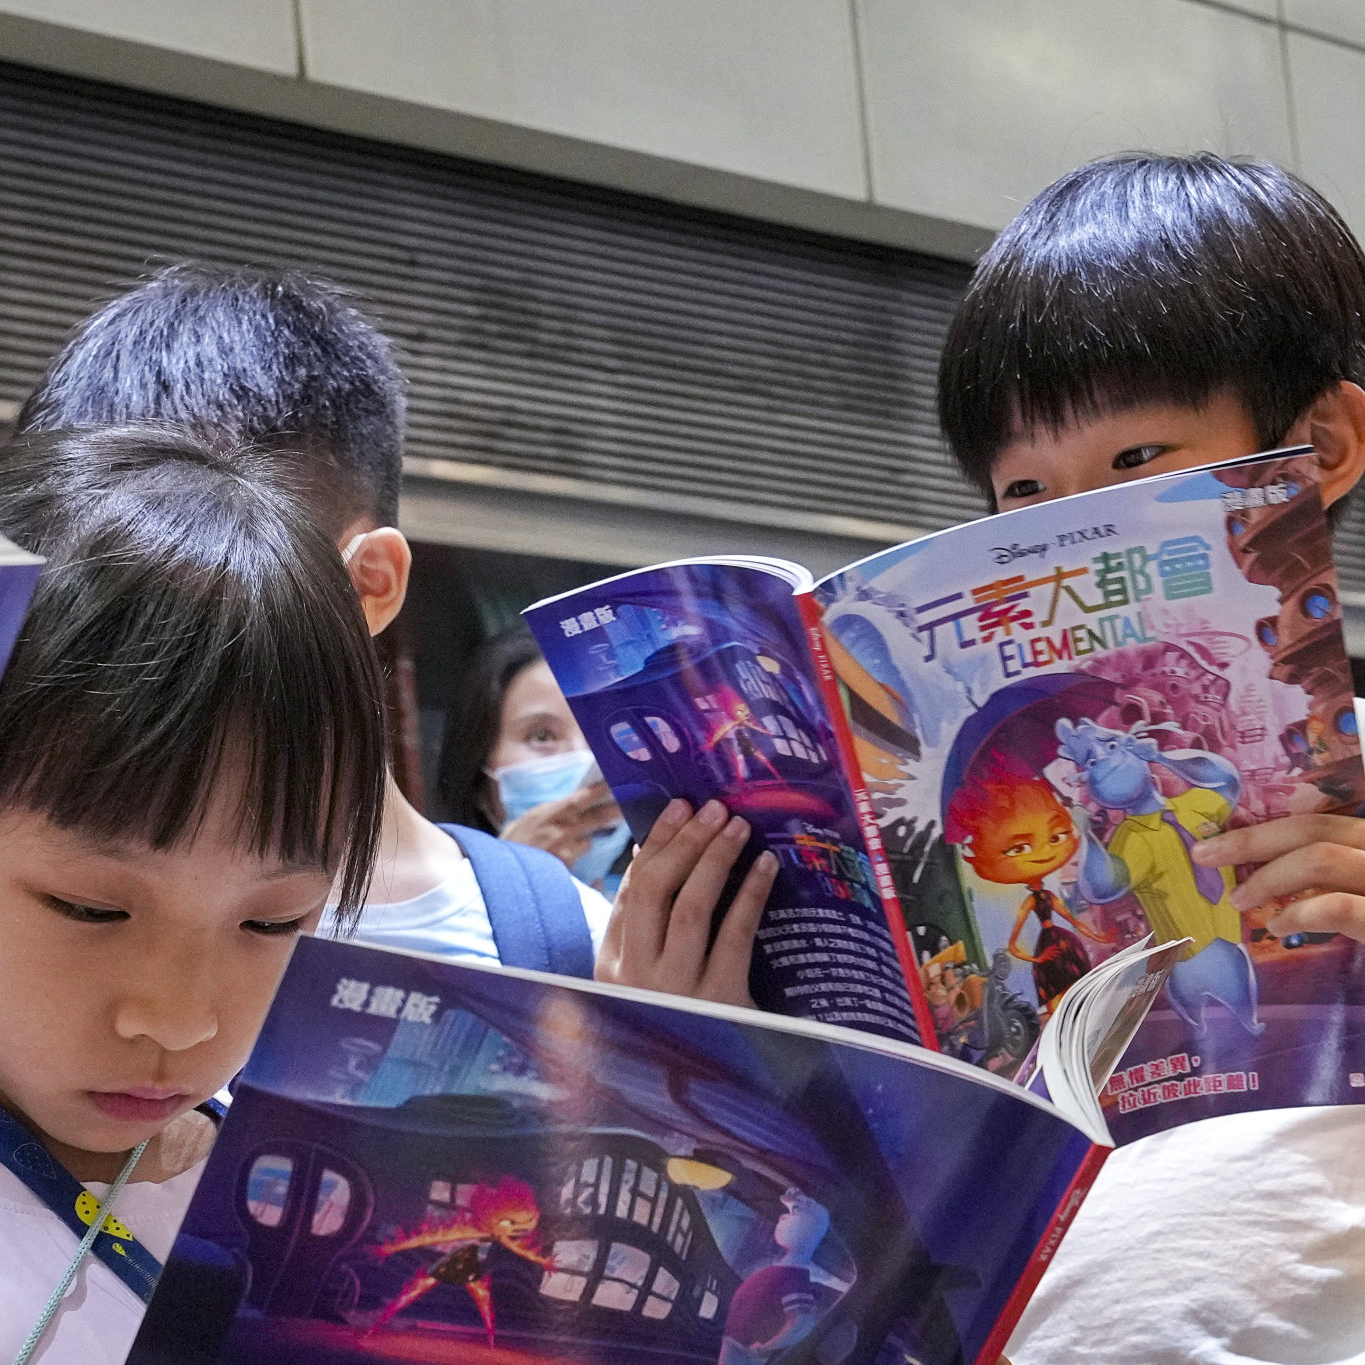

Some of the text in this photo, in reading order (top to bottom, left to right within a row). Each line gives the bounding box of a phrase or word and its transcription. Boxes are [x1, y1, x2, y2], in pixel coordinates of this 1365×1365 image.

[989, 524, 1121, 565] Disney PIXAR
[559, 604, 617, 638] 漫畫版
[914, 535, 1214, 663] 元素大都會
[998, 612, 1158, 679] ELEMENTAL
[331, 977, 441, 1025] 漫畫版
[1119, 1072, 1260, 1114] 拉近彼此距離！
